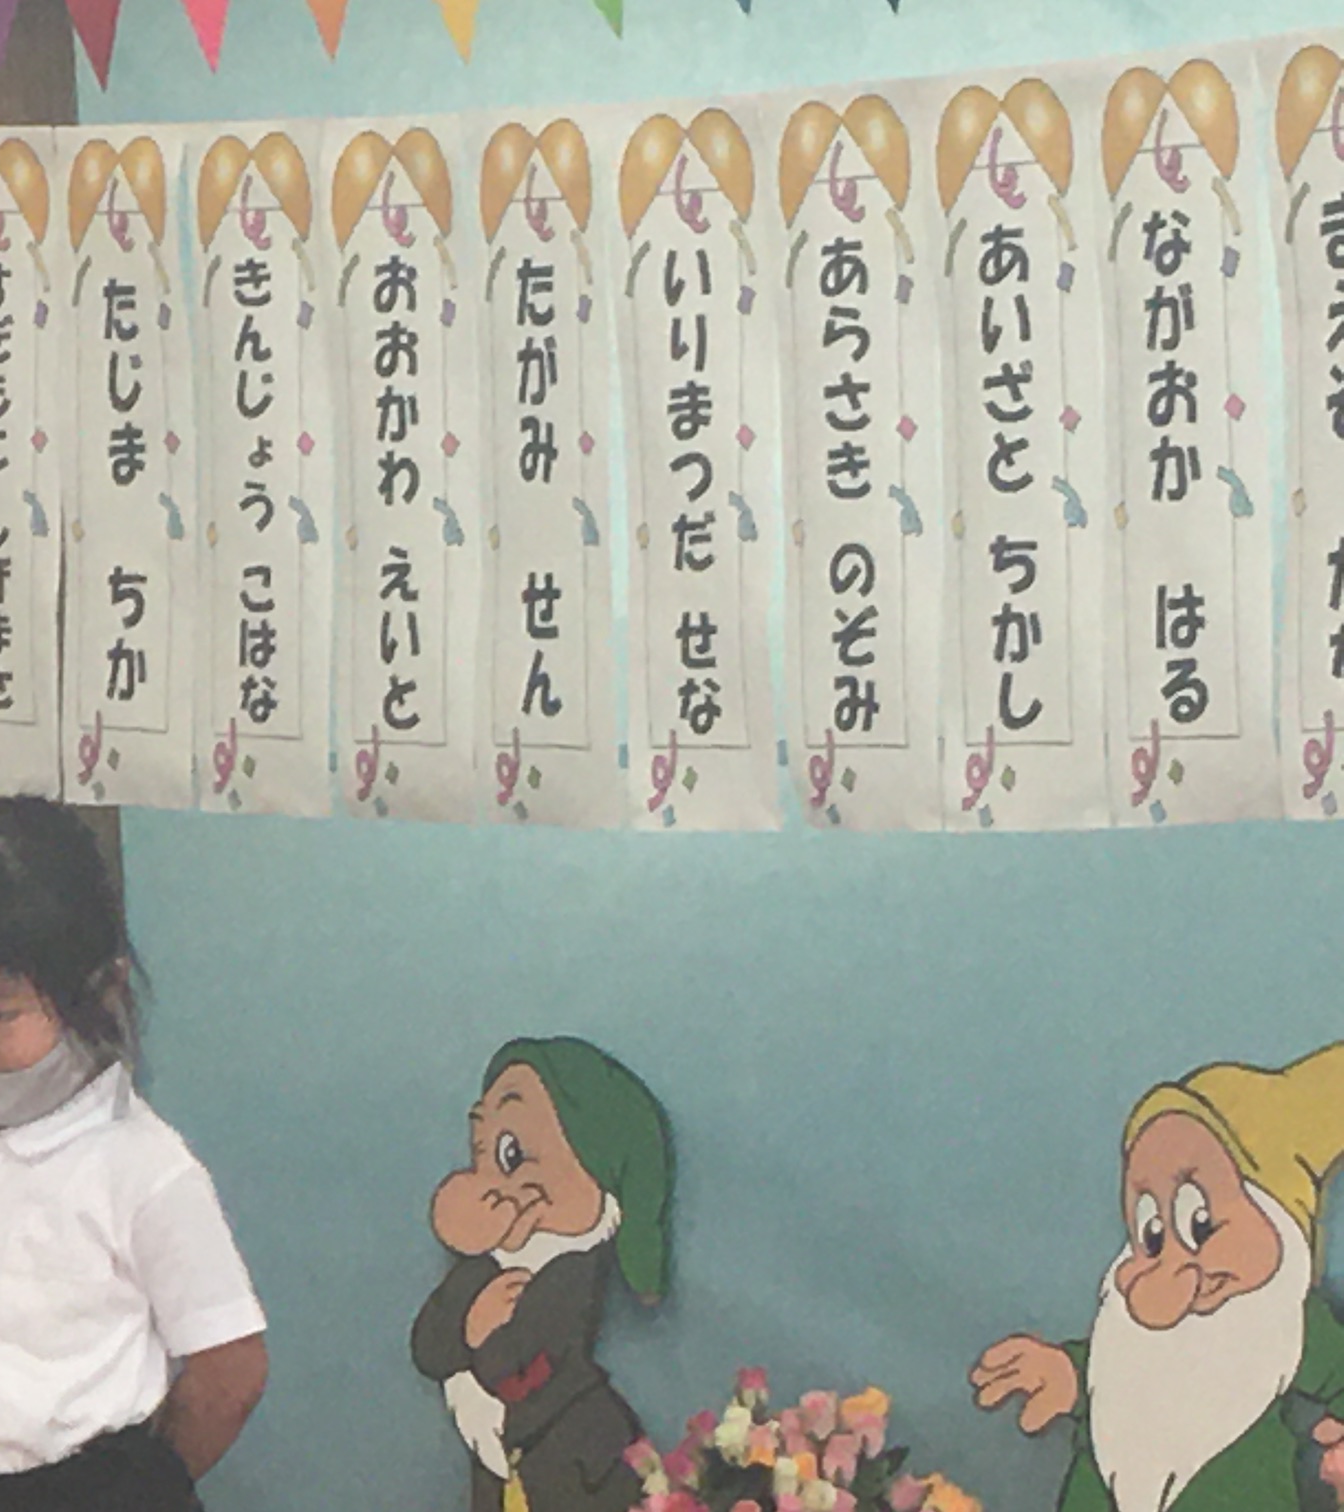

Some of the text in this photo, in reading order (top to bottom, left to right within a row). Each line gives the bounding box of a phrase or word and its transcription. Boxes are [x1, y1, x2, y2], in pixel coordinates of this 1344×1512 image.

[103, 278, 149, 702] たじま ちか
[234, 258, 279, 724] きんじょう こはな
[374, 256, 421, 731] おおかわ えいと
[517, 258, 563, 718] たがみ せん
[665, 250, 723, 736] いりまつだ せな
[820, 237, 881, 733] あらさき のぞみ
[979, 224, 1043, 731] あいざと ちかし
[1143, 210, 1209, 724] ながおか はる
